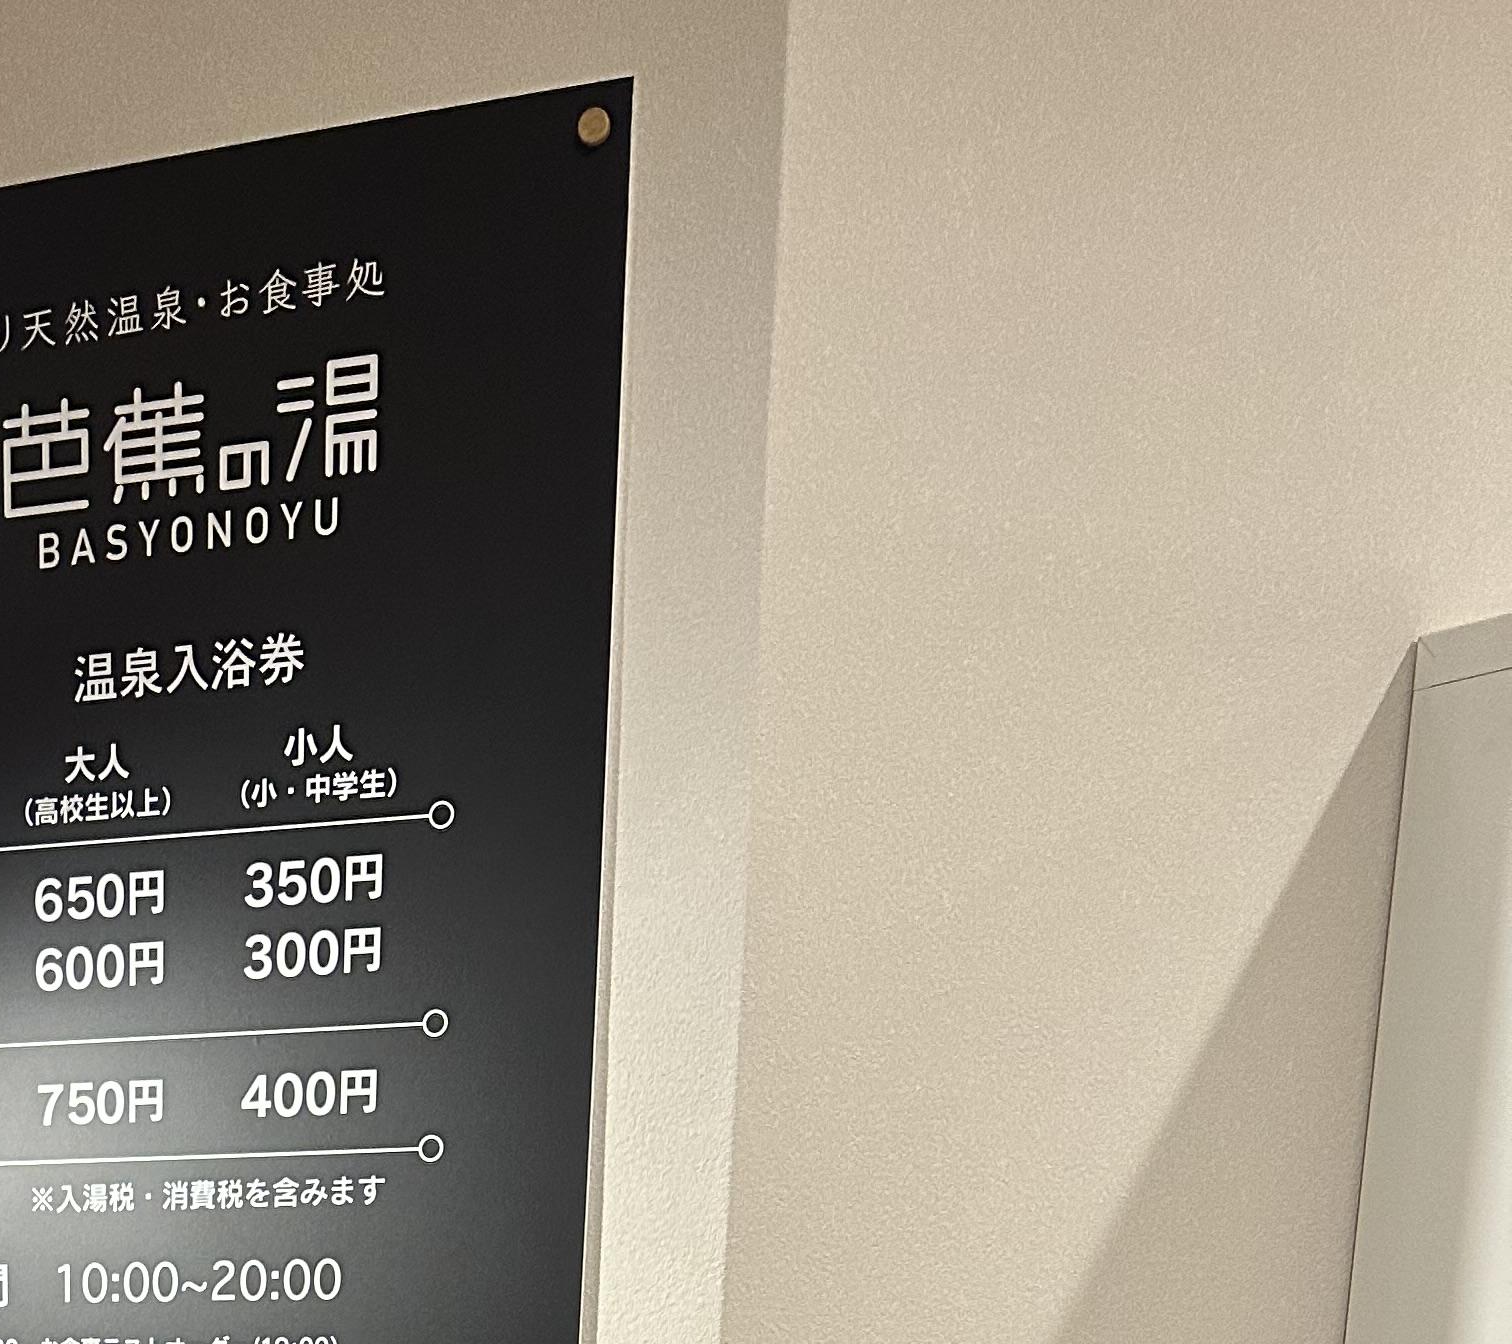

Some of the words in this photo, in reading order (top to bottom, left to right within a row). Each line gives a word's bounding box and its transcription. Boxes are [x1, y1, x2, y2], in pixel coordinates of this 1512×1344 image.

[2, 353, 379, 518] 芭蕉の湯
[38, 498, 339, 569] BASYONOYU
[75, 632, 304, 702] 温泉入浴券
[65, 743, 129, 783] 大人
[284, 724, 353, 766] 小人
[34, 869, 166, 922] 650円
[244, 854, 383, 908] 350円
[34, 941, 165, 991] 600円
[243, 927, 382, 979] 300円
[37, 1079, 165, 1125] 750円
[241, 1069, 378, 1118] 400円
[32, 1175, 385, 1212] ※入湯税・消費税を含みます
